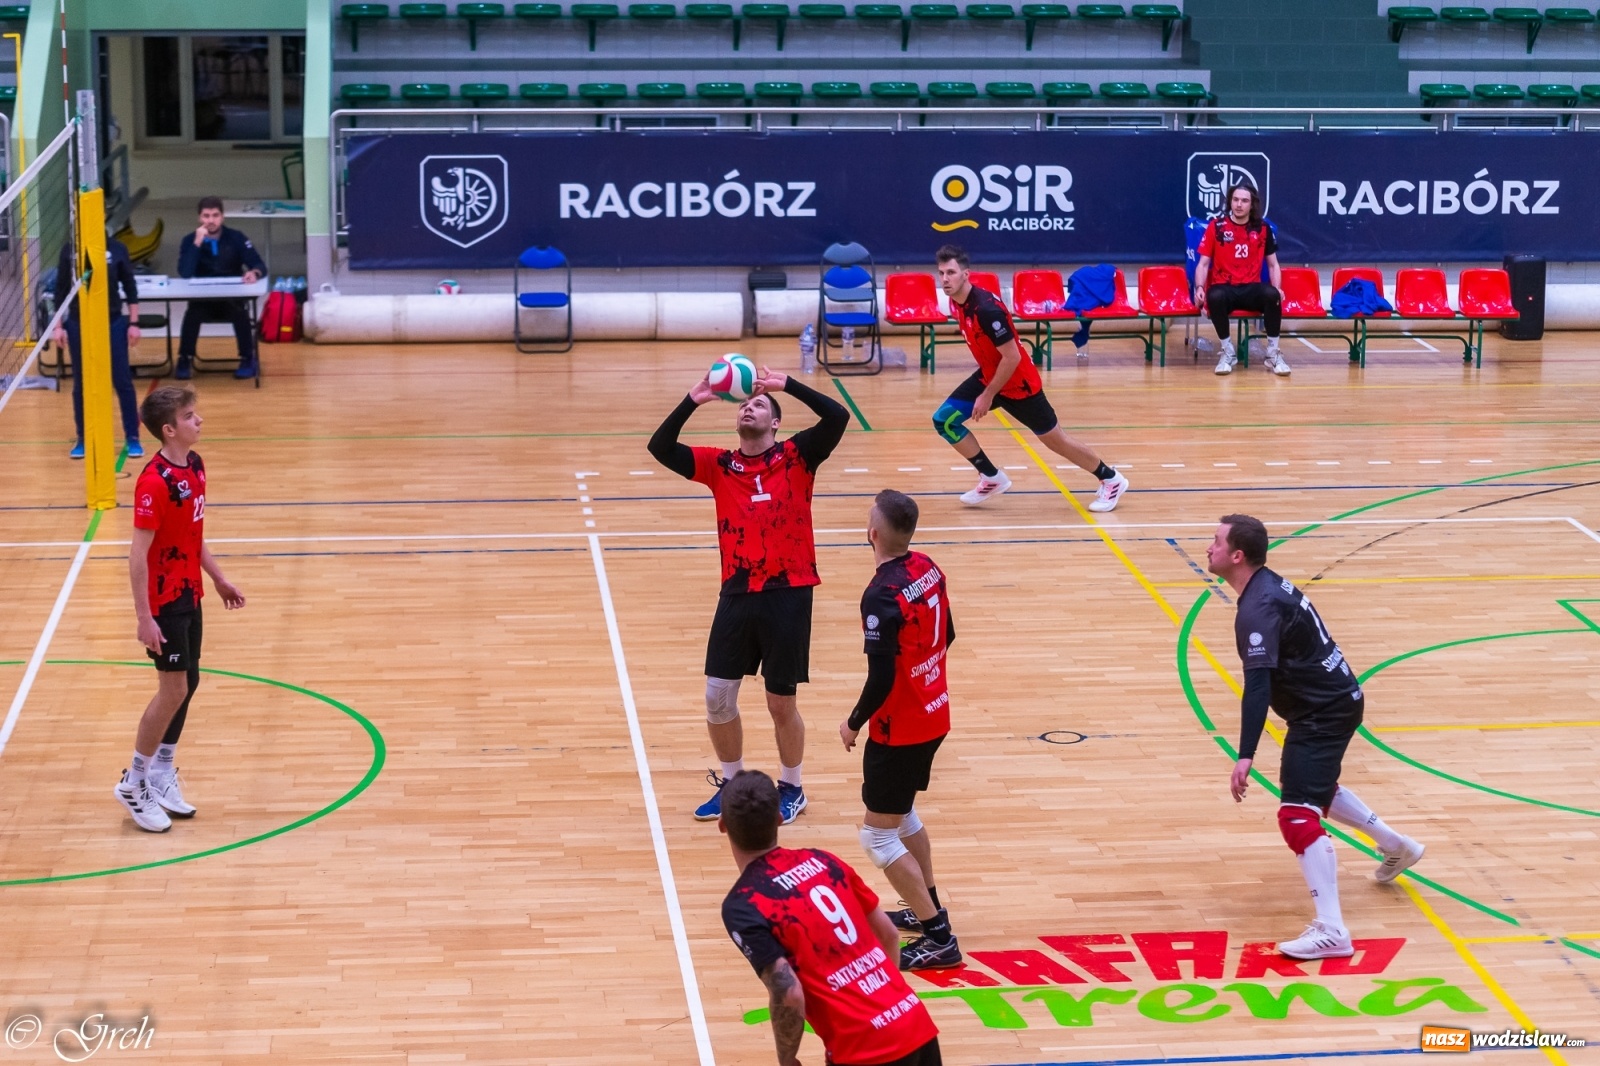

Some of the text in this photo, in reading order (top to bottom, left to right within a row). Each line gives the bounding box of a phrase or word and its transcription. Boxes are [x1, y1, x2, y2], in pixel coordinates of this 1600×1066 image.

[559, 168, 817, 219] RACIBÓRZ
[930, 164, 1075, 213] OSiR
[1318, 167, 1560, 215] RACIBÓRZ
[988, 213, 1075, 231] RACIBÓRZ
[1234, 244, 1249, 258] 23
[751, 474, 771, 502] 1
[927, 593, 941, 648] 7
[772, 857, 828, 891] TATERKA
[809, 884, 858, 946] 9
[870, 1014, 887, 1030] WE
